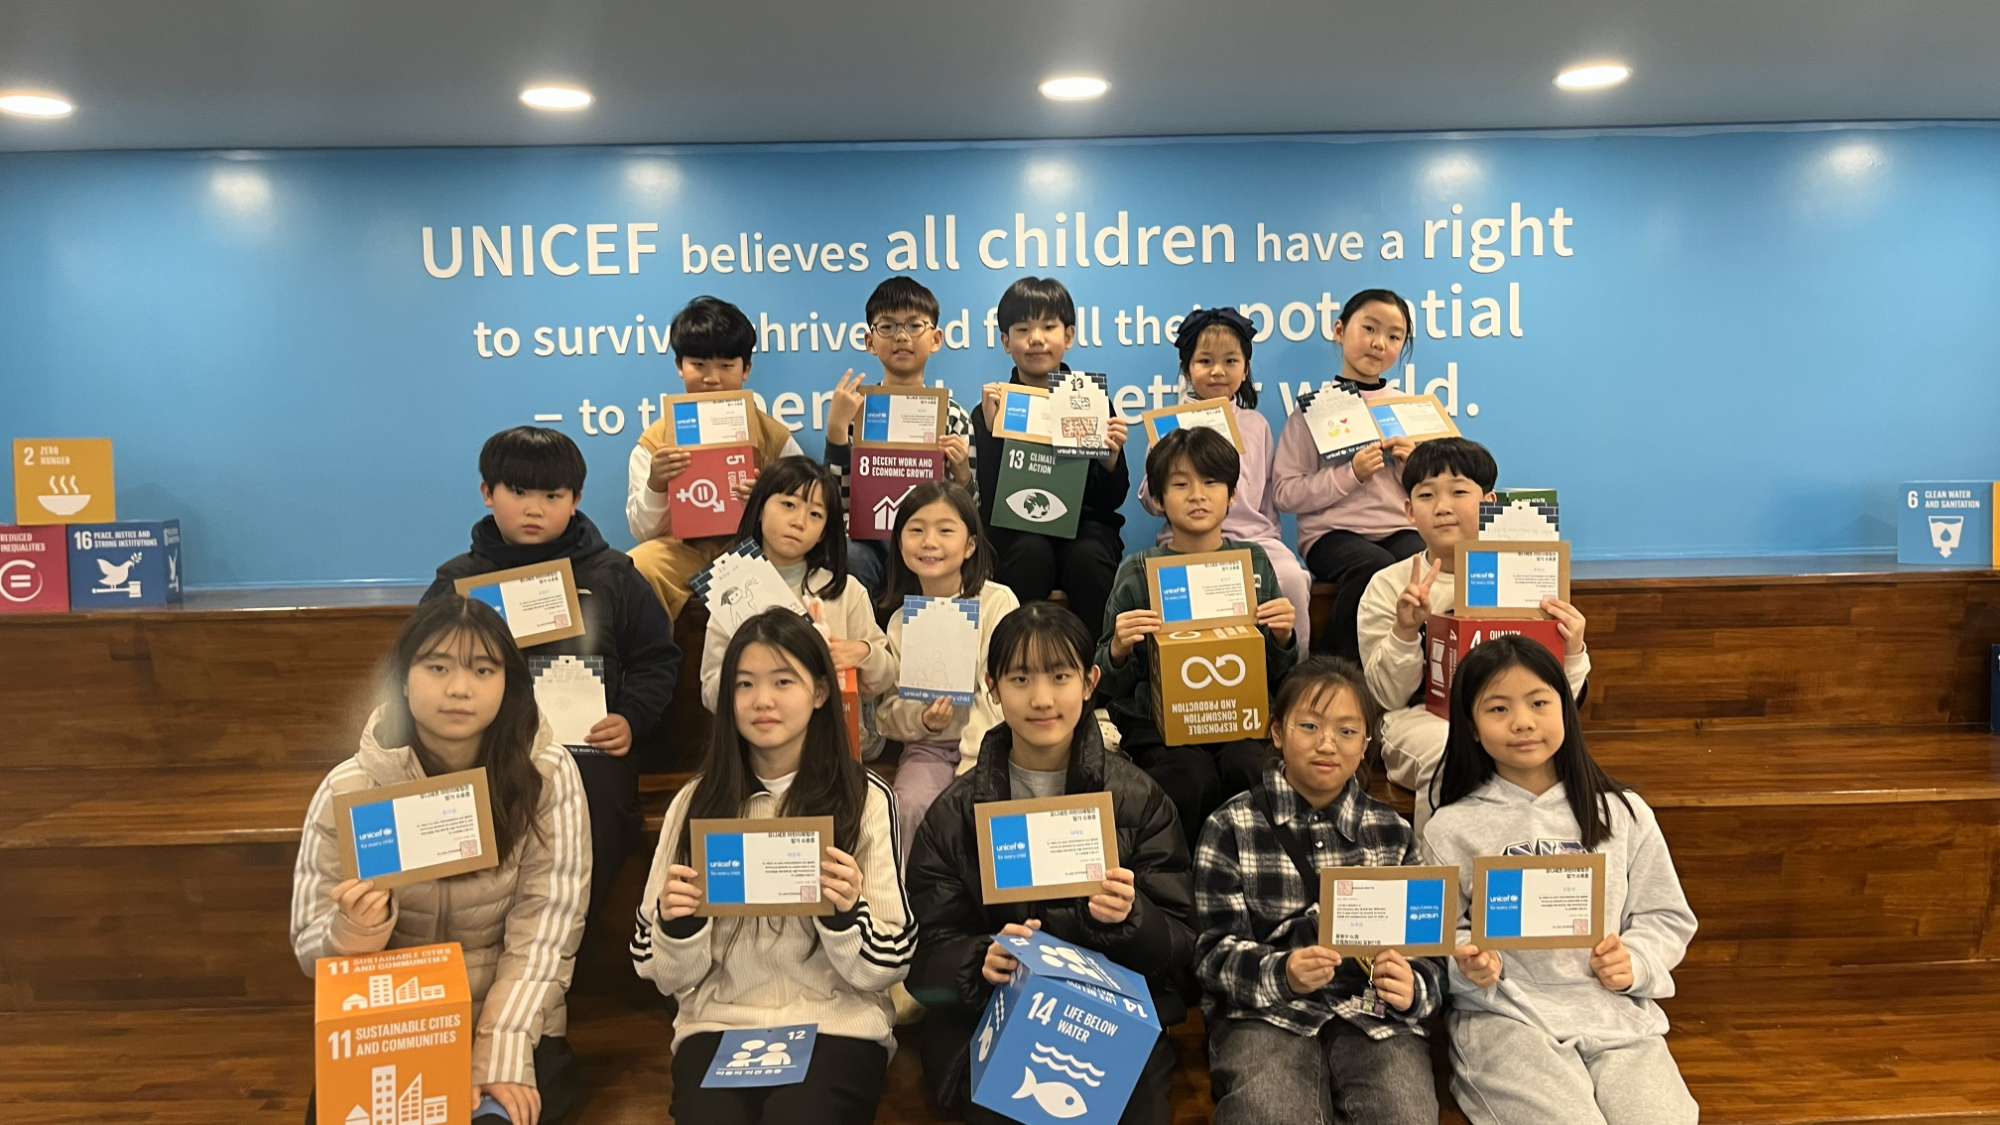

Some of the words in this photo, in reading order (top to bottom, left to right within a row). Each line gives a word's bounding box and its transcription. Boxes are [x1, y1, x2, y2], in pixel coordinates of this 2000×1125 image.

[421, 222, 660, 279] UNICEF
[681, 232, 870, 274] believes
[884, 214, 960, 271] all
[977, 210, 1236, 270] children
[1256, 222, 1365, 263] have
[1379, 230, 1405, 261] a
[1423, 202, 1575, 274] right
[473, 321, 522, 358] to
[579, 399, 625, 436] to
[23, 446, 36, 467] 2
[40, 446, 60, 456] ZERO
[40, 456, 71, 466] HUNGER
[725, 454, 746, 465] 5
[872, 456, 897, 467] DECENT
[898, 457, 917, 468] WORK
[918, 458, 933, 469] AND
[1008, 449, 1025, 470] 13
[1029, 452, 1056, 466] CLIMATE
[859, 456, 870, 477] 8
[872, 467, 905, 478] ECONOMIC
[906, 468, 934, 479] GROWTH
[1028, 463, 1052, 475] ACTION
[1907, 489, 1920, 509] 6
[1924, 490, 1947, 499] CLEAN
[1948, 490, 1971, 499] WATER
[1924, 500, 1940, 509] AND
[1941, 500, 1980, 509] SANITATION
[74, 530, 93, 551] 16
[138, 530, 151, 539] AND
[94, 539, 118, 549] STRONG
[1163, 587, 1180, 595] unicef
[1470, 630, 1481, 649] 4
[904, 690, 922, 698] unicef
[1172, 699, 1219, 713] PRODUCTION
[1221, 699, 1236, 708] AND
[1184, 710, 1237, 724] CONSUMPTION
[1243, 708, 1262, 730] 12
[1188, 721, 1238, 736] RESPONSIBLE
[359, 828, 383, 840] unicef
[996, 842, 1017, 851] unicef
[710, 860, 731, 868] unicef
[1490, 895, 1510, 903] unicef
[1418, 912, 1439, 920] unicef
[353, 950, 418, 966] SUSTAINABLE
[421, 948, 452, 958] CITIES
[353, 962, 376, 973] AND
[377, 955, 449, 970] COMMUNITIES
[327, 960, 349, 975] 11
[1027, 991, 1058, 1026] 14
[1122, 997, 1148, 1018] 14
[355, 1020, 427, 1041] SUSTAINABLE
[428, 1013, 461, 1028] CITIES
[1063, 1003, 1085, 1023] LIFE
[1084, 1012, 1119, 1038] BELOW
[787, 1030, 806, 1040] 12
[1057, 1019, 1090, 1044] WATER
[328, 1029, 351, 1060] 11
[356, 1040, 380, 1057] AND
[381, 1030, 457, 1052] COMMUNITIES
